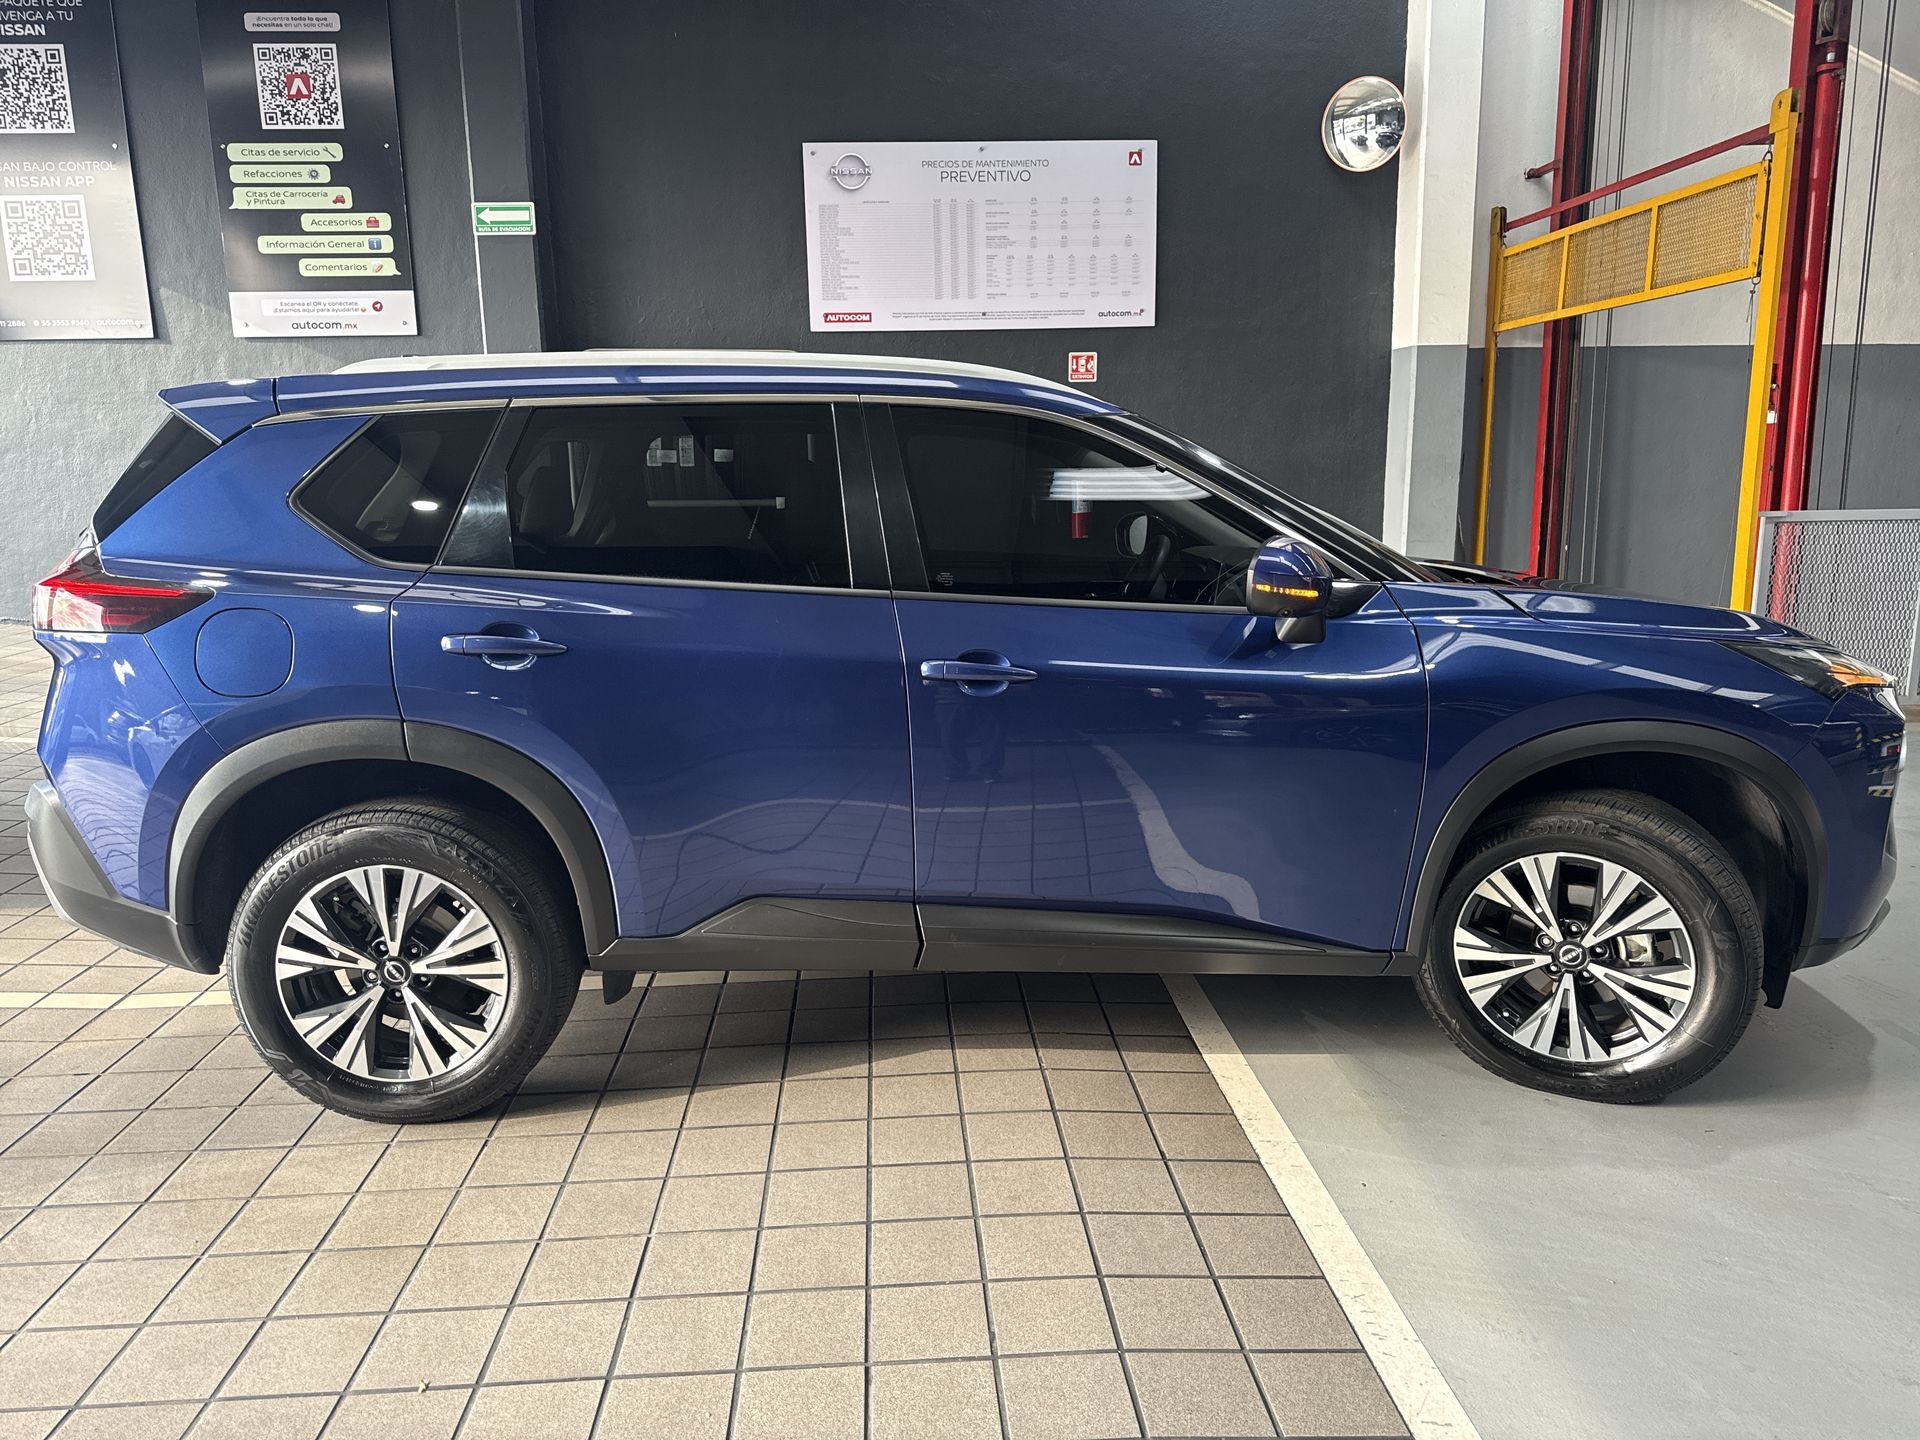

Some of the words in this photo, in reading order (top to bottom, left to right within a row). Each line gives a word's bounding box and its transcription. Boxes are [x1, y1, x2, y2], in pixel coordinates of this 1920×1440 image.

[0, 10, 45, 21] VENGA
[46, 10, 56, 21] A
[56, 10, 74, 21] TU
[240, 148, 266, 157] Citas
[268, 148, 280, 157] de
[282, 148, 320, 157] servicio
[22, 161, 56, 172] BAJO
[58, 160, 118, 172] CONTROL
[921, 159, 960, 169] PRECIOS
[961, 159, 974, 169] DE
[975, 158, 1050, 168] MANTENIMIENTO
[243, 169, 303, 178] Refacciones
[829, 166, 873, 177] NISSAN
[939, 169, 1032, 183] PREVENTIVO
[3, 175, 61, 188] NISSAN
[64, 175, 96, 188] APP
[245, 190, 269, 198] Citas
[269, 190, 280, 198] de
[253, 197, 286, 205] Pintura
[310, 218, 363, 226] Accesorios
[266, 240, 326, 249] Información
[327, 240, 365, 248] General
[304, 263, 368, 271] Comentarios
[826, 313, 870, 322] AUTOCOM
[291, 320, 358, 330] autocom.mx
